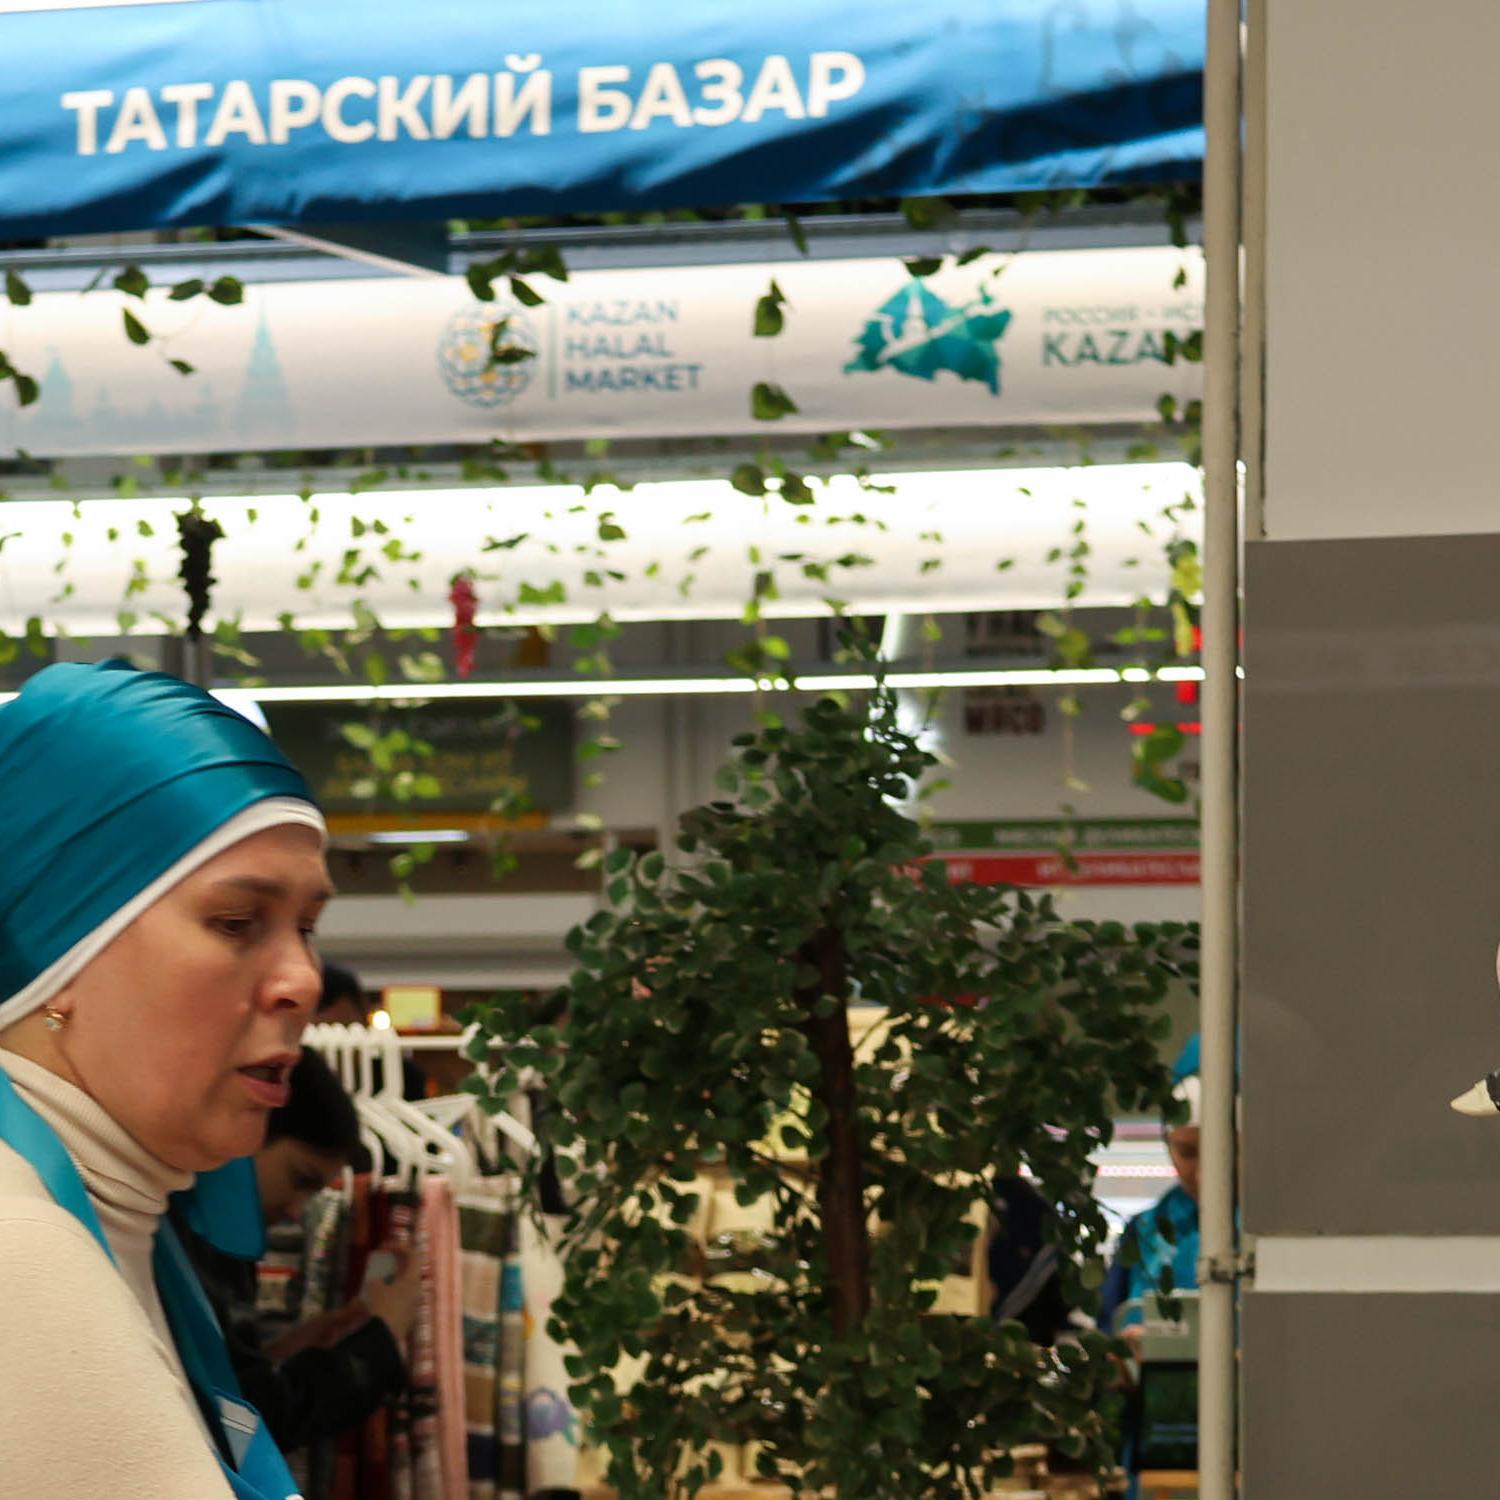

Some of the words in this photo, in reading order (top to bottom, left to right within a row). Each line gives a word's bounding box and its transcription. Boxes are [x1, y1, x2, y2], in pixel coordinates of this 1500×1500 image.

[61, 55, 552, 156] ТАТАРСКИЙ
[578, 51, 866, 132] БАЗАР
[566, 300, 679, 325] KAZAN
[565, 332, 675, 359] HALAL
[1043, 330, 1204, 367] KAZA
[565, 363, 703, 392] MARKET
